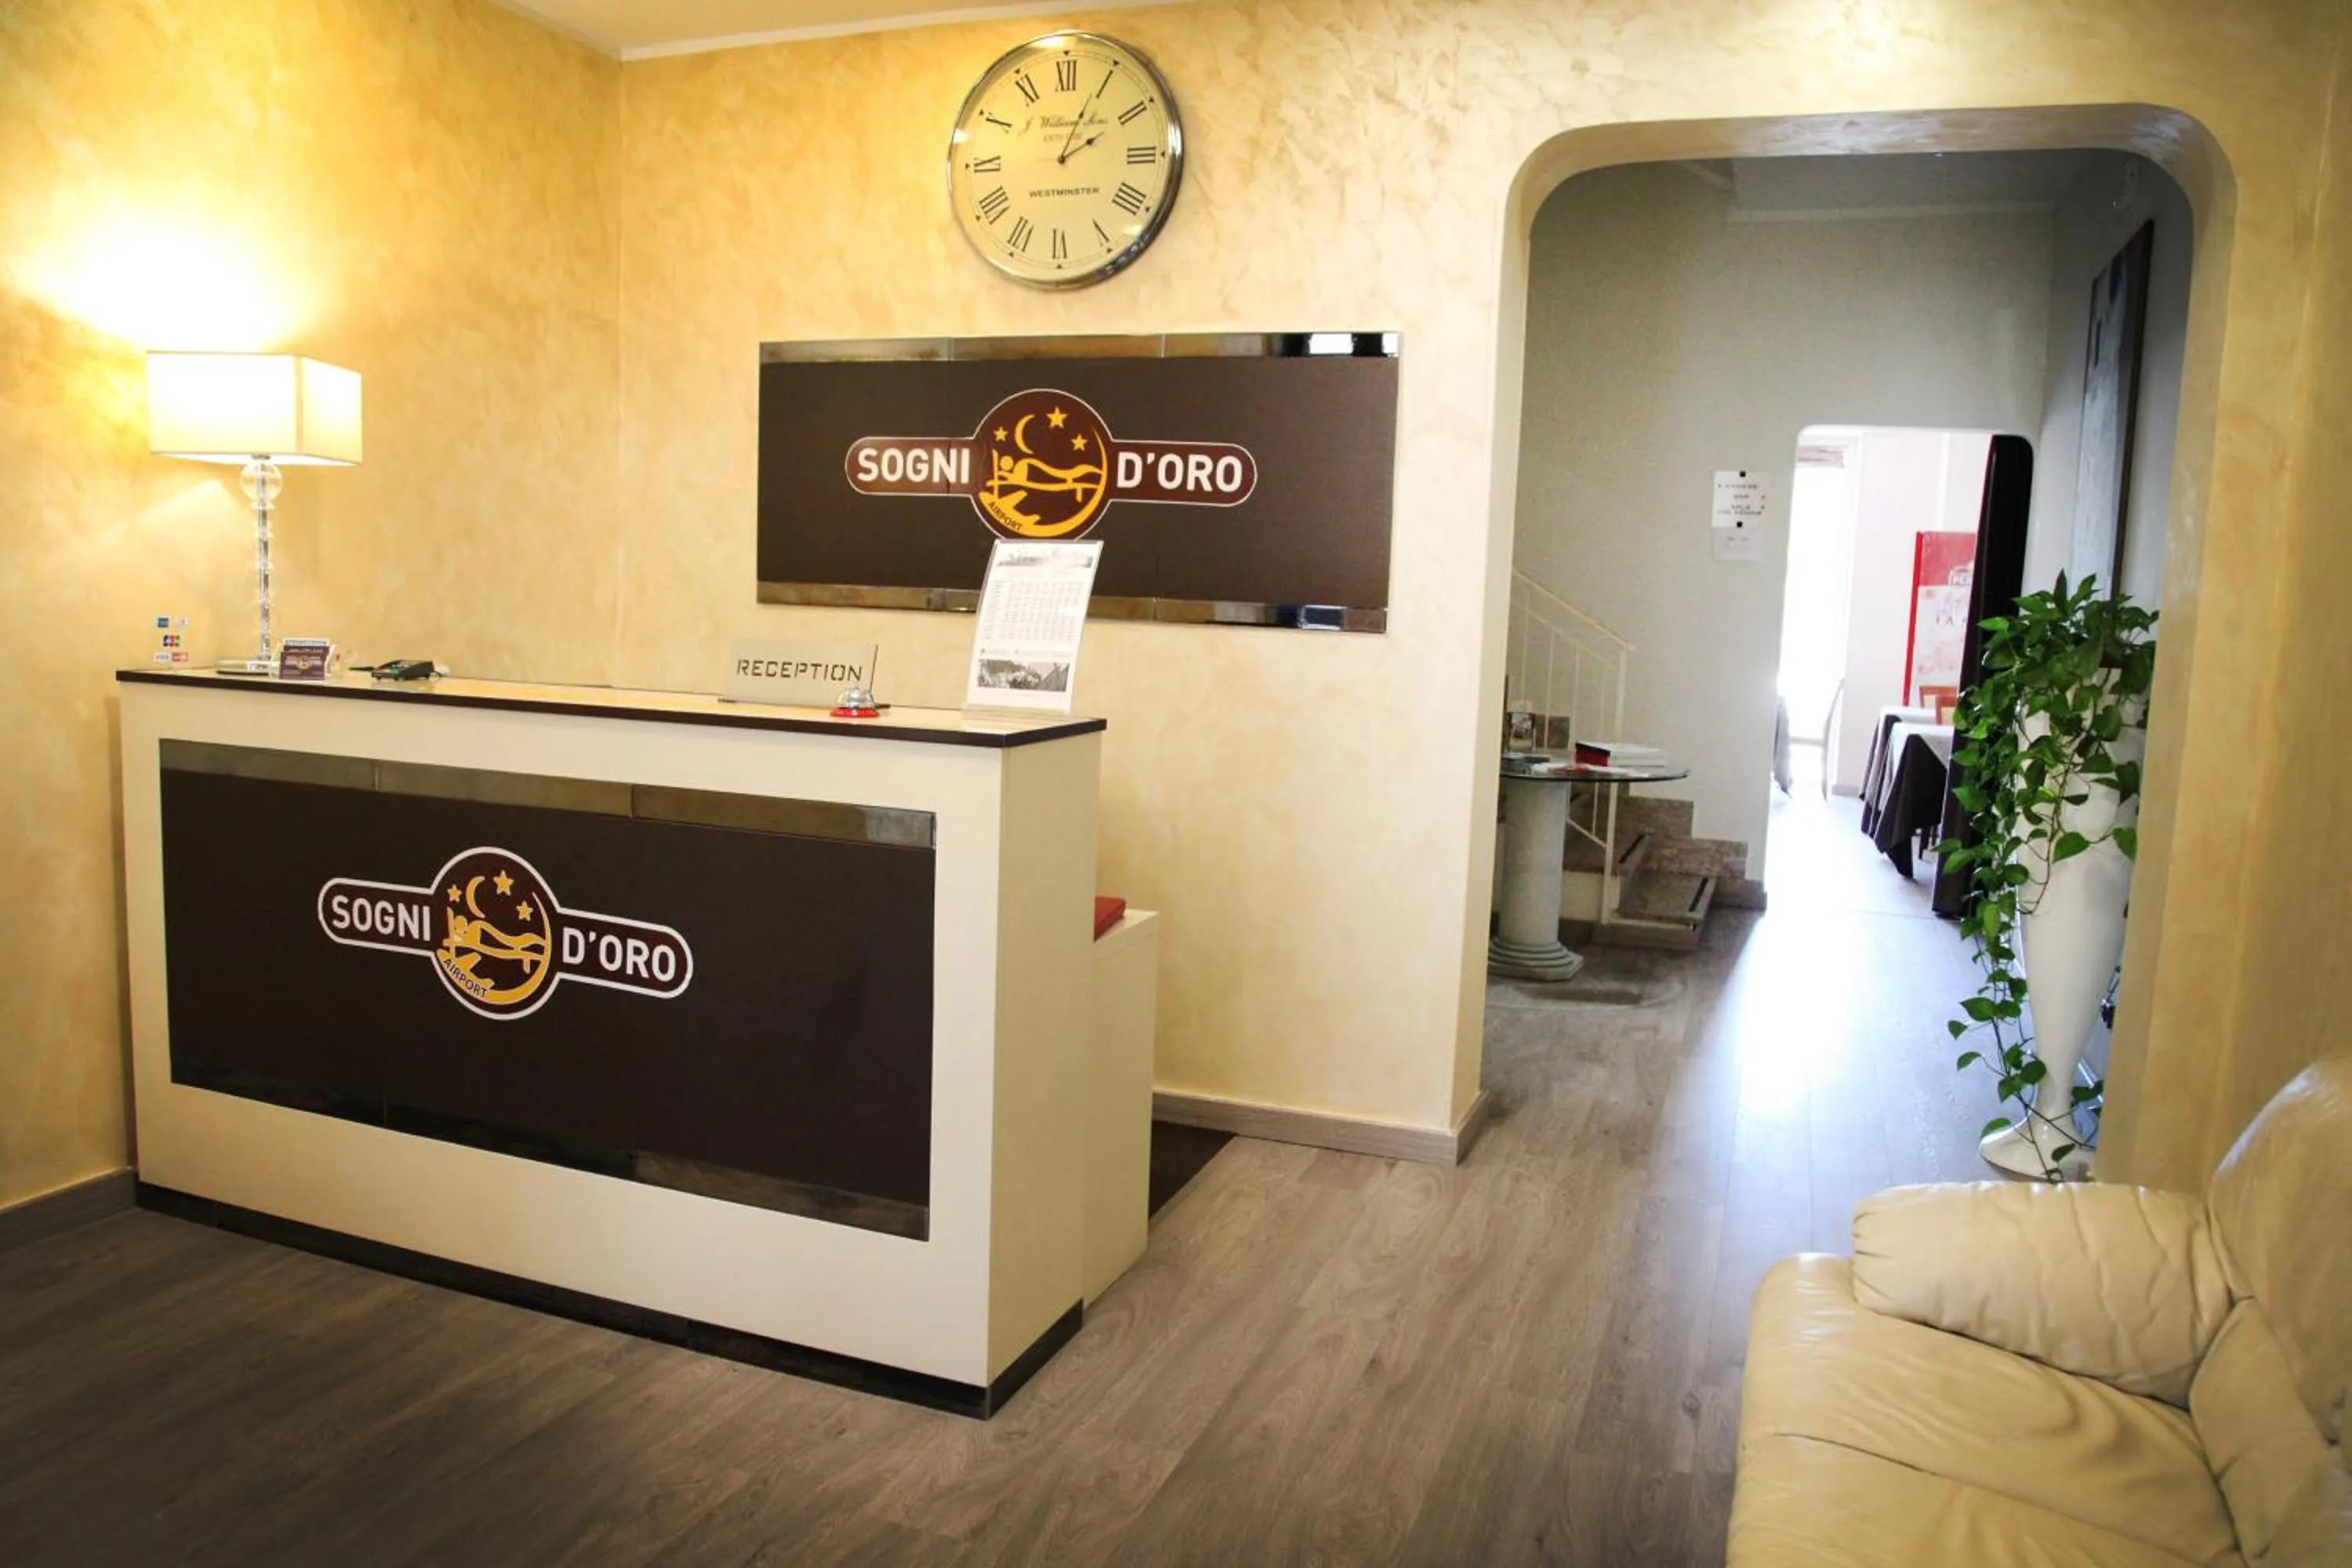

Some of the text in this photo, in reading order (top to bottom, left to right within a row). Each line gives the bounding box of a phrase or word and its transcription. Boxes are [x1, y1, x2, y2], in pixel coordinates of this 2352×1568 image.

[1015, 74, 1040, 107] XI
[1055, 60, 1077, 92] XII
[1117, 100, 1148, 125] II
[1127, 146, 1156, 165] III
[1029, 187, 1100, 198] WESTMINSTER
[1007, 216, 1035, 253] VII
[1051, 228, 1068, 260] VI
[857, 448, 1243, 492] SOGNI D'ORO
[988, 501, 1022, 531] AIRPORT
[736, 659, 862, 681] RECEPTION
[332, 895, 675, 982] SOGNI D'ORO
[444, 959, 486, 998] AIRPORT
